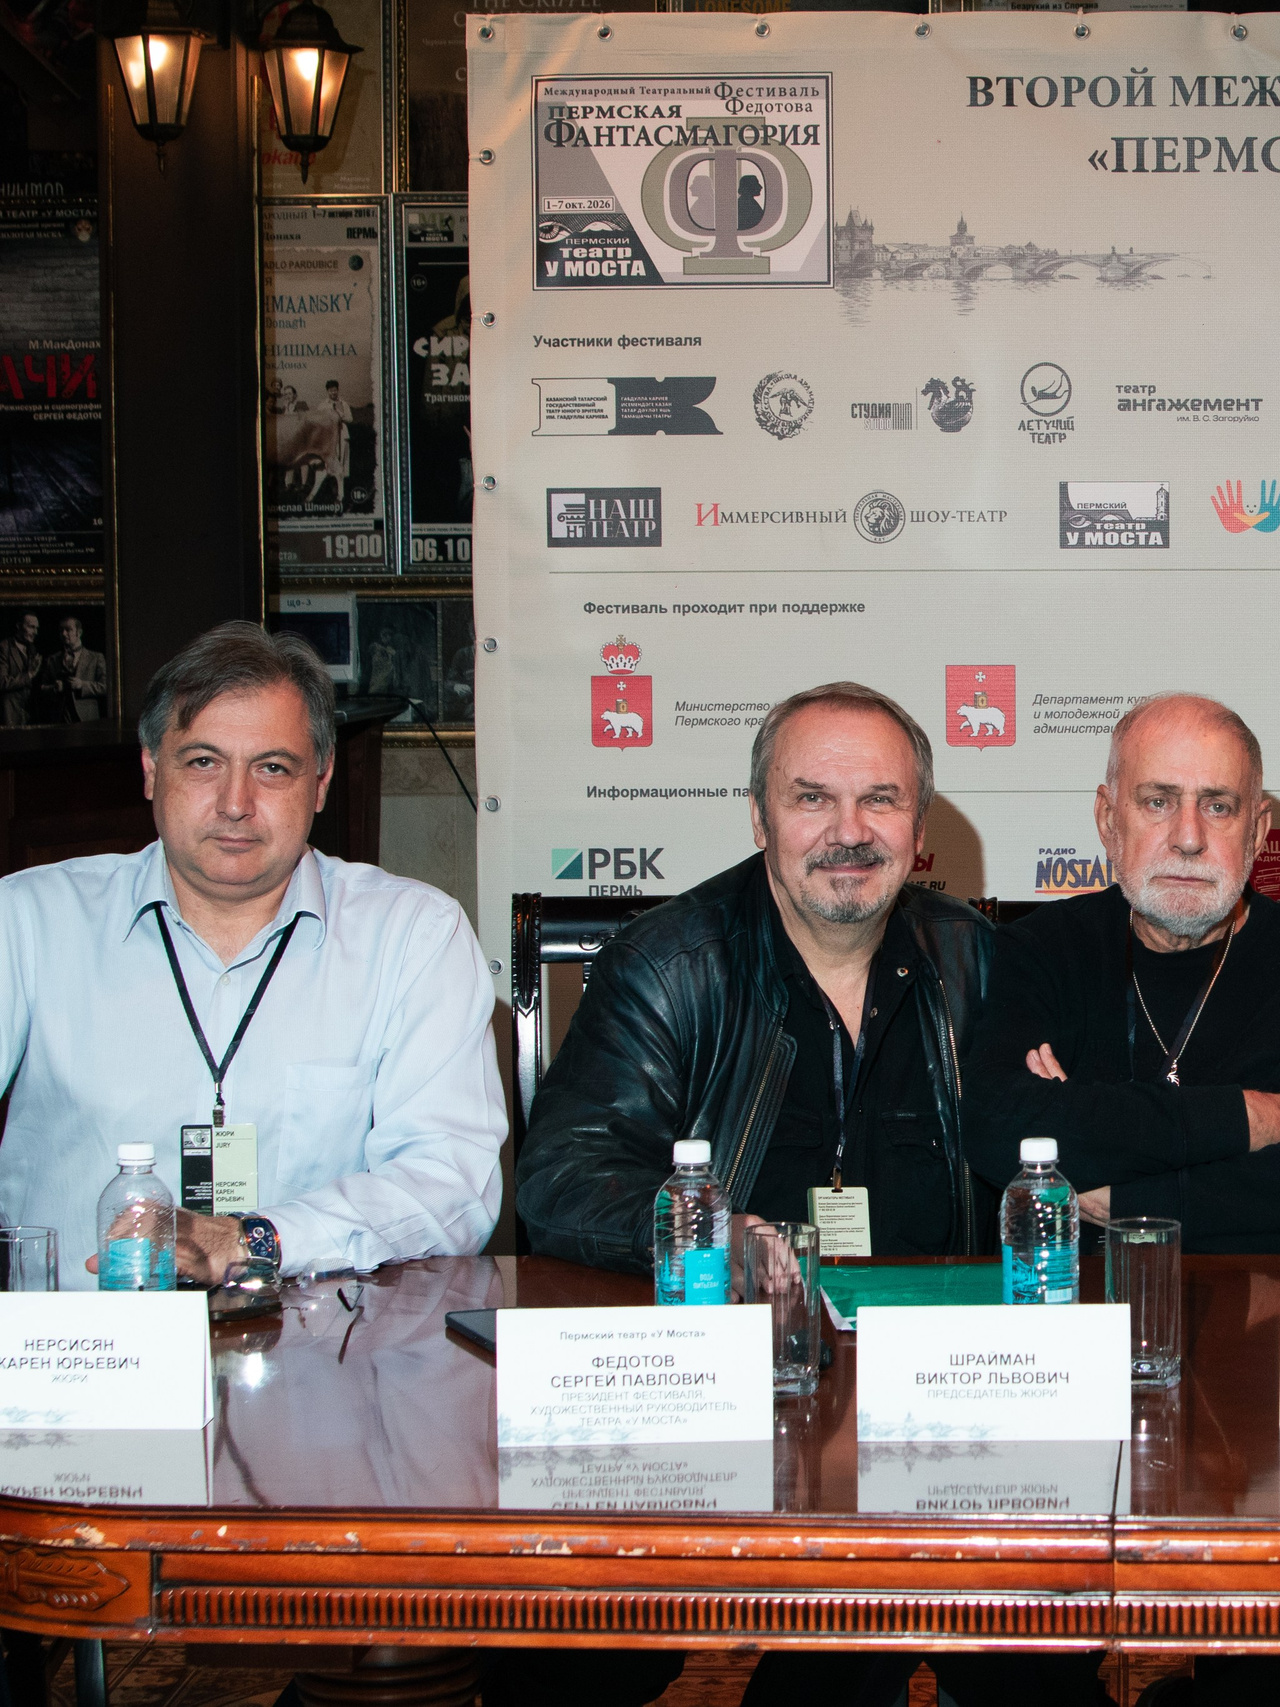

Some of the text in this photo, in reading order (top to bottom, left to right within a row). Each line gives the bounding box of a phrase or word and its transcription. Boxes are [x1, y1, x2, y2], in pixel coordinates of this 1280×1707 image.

[544, 82, 820, 101] Международный Театральный Фестиваль
[966, 69, 1155, 109] ВТОРОЙ
[548, 105, 682, 119] ПЕРМСКАЯ
[725, 97, 813, 115] Федотова
[543, 118, 820, 148] ФАНТАСМАГОРИЯ
[565, 200, 611, 210] окт. 2026
[346, 227, 378, 239] ПЕРМЬ
[565, 237, 630, 246] ПЕРМСКИЙ
[559, 247, 632, 259] театр
[288, 260, 338, 270] PARDUBICE
[545, 260, 646, 276] У МОСТА
[533, 335, 702, 349] Участники фестиваля
[1115, 384, 1156, 397] театр
[851, 403, 891, 419] СТУДИЯ
[1117, 398, 1263, 412] ангажемент
[1018, 416, 1074, 431] ЛЕТУЧИЙ
[1213, 414, 1260, 423] Загоруйко
[1029, 432, 1067, 444] ТЕАТР
[589, 499, 655, 519] НАШ
[1077, 502, 1127, 510] ПЕРМСКИЙ
[695, 503, 847, 526] ИММЕРСИВНЫЙ
[910, 510, 1008, 523] ШОУ-ТЕАТР
[588, 520, 656, 537] ТЕАТР
[1094, 522, 1146, 530] театр
[1066, 531, 1163, 546] У МОСТА
[322, 534, 383, 558] 19:00
[413, 537, 471, 562] 06.10
[583, 602, 865, 615] Фестиваль проходит при поддержке
[675, 701, 770, 713] Министерство
[1032, 694, 1123, 706] Департамент
[1034, 709, 1120, 719] и молодежной
[675, 716, 765, 728] Пермского кра
[1033, 723, 1113, 736] администра
[587, 785, 728, 800] Информационные
[588, 848, 664, 880] РБК
[1035, 855, 1114, 889] NOSTAL
[589, 885, 642, 896] ПЕРМЬ
[560, 1331, 614, 1342] Пермский
[616, 1332, 647, 1341] театр
[667, 1329, 706, 1339] Моста»
[24, 1339, 114, 1352] НЕРСИСЯН
[57, 1357, 140, 1370] ЮРЬЕВИЧ
[591, 1355, 675, 1369] ФЕДОТОВ
[950, 1351, 1035, 1366] ШРАЙМАН
[551, 1372, 716, 1388] СЕРГЕЙ ПАВЛОВИЧ
[916, 1371, 1069, 1385] ВИКТОР ЛЬВОВИЧ
[562, 1392, 629, 1402] ПРЕЗИДЕНТ
[927, 1388, 1058, 1400] ПРЕДСЕДАТЕЛЬ ЖЮРИ
[530, 1402, 737, 1416] ХУДОЖЕСТВЕННЫЙ РУКОВОДИТЕЛЬ
[580, 1415, 688, 1427] ТЕАТРА МОСТА»
